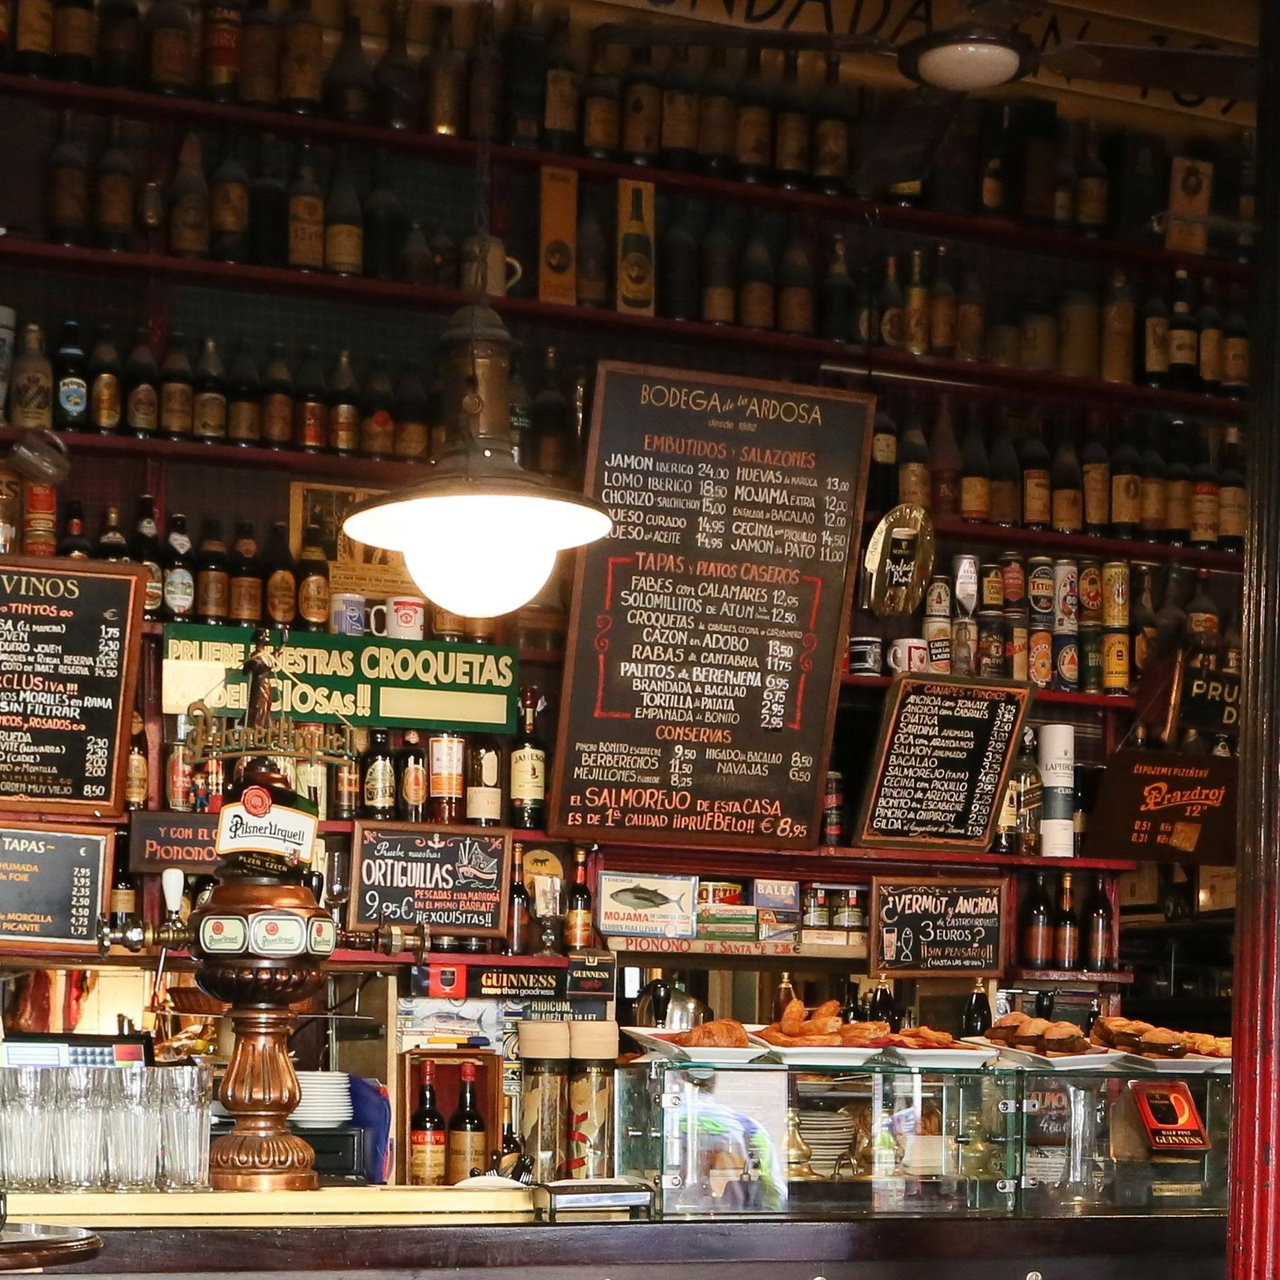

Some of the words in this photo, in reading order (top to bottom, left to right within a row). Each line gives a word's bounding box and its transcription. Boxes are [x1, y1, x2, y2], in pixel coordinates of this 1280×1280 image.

[641, 384, 721, 413] BODEGA
[746, 398, 822, 425] ARDOSA
[709, 419, 734, 430] desde
[644, 434, 727, 459] EMBUTIDOS
[740, 446, 816, 468] SALAZONES
[605, 453, 653, 470] JAMON
[656, 461, 694, 475] IBERICO
[604, 472, 644, 488] LOMO
[647, 475, 693, 494] IBERICO
[736, 466, 783, 484] HUEVAS
[734, 485, 789, 506] MOJAMA
[645, 513, 687, 529] CURADO
[732, 521, 774, 539] CECINA
[731, 539, 774, 554] JAMON
[784, 543, 815, 559] PATO
[635, 552, 684, 574] TAPAS
[696, 562, 737, 579] PLATOS
[740, 563, 800, 584] CASEROS
[885, 558, 915, 577] Perfect
[892, 571, 913, 584] Pint
[0, 574, 80, 599] VINOS
[631, 576, 672, 593] FABES
[675, 581, 696, 596] con
[698, 582, 768, 602] CALAMARES
[8, 602, 58, 617] TINTOS
[620, 591, 702, 614] SOLOMILLITOS
[720, 601, 754, 619] ATUN
[626, 609, 695, 630] CROQUETAS
[0, 641, 30, 653] DUERO
[33, 644, 62, 654] JOVEN
[702, 633, 750, 652] ADOBO
[631, 644, 684, 663] RABAS
[700, 652, 759, 668] CANTABRIA
[360, 645, 514, 688] CROQUETAS
[620, 661, 675, 680] PALITOS
[692, 667, 762, 688] BERENJENA
[632, 678, 692, 695] BRANDADA
[704, 684, 747, 698] BACALAO
[20, 691, 69, 705] MORILES
[83, 697, 113, 709] RAMA
[640, 692, 693, 710] TORTILLA
[701, 699, 735, 712] PATATA
[905, 695, 940, 706] ANCHOA
[956, 700, 989, 710] TOMATE
[0, 702, 24, 713] SIN
[27, 704, 80, 719] FILTRAR
[634, 707, 693, 723] EMPANADA
[704, 712, 740, 726] BONITO
[902, 704, 938, 715] ANCHOA
[901, 713, 938, 725] CHATKA
[655, 725, 732, 744] CONSERVAS
[898, 722, 939, 735] SARDINA
[705, 748, 739, 761] HIGADO
[892, 745, 932, 756] SALMON
[581, 753, 659, 770] BERBERECHOS
[889, 755, 937, 767] BACALAO
[573, 767, 637, 783] MEJILLONES
[717, 762, 769, 777] NAVAJAS
[886, 766, 945, 780] SALMOREJO
[931, 780, 967, 792] PIQUILLO
[585, 787, 692, 810] SALMOREJO
[697, 800, 710, 812] DE
[714, 801, 740, 814] ESTA
[742, 799, 782, 816] CASA
[924, 791, 967, 802] ARENQUE
[1141, 782, 1226, 811] Prazdroj
[567, 813, 581, 826] ES
[587, 814, 601, 825] DE
[625, 814, 669, 828] CALIDAD
[776, 818, 807, 838] 8,95
[873, 818, 902, 829] GILDA
[158, 826, 167, 838] Y
[169, 827, 193, 840] CON
[197, 828, 210, 840] EL
[2, 837, 46, 853] TAPAS
[374, 841, 405, 858] Pruebe
[408, 849, 441, 859] nuestras
[9, 872, 30, 882] FOIE
[362, 859, 453, 889] ORTIGUILLAS
[414, 889, 452, 900] PESCADAS
[757, 883, 795, 897] BALEA
[459, 900, 495, 912] BARBATE
[955, 896, 999, 915] ANCHOA
[7, 913, 53, 924] MORCILLA
[604, 911, 650, 922] MOJAMA
[2, 923, 41, 933] PICANTE
[919, 920, 934, 942] 3
[624, 938, 691, 953] PIONONO
[704, 943, 715, 952] DE
[720, 942, 752, 954] SANTA
[481, 973, 557, 988] GUINNESS
[572, 970, 609, 979] GUINNESS
[482, 987, 501, 995] more
[502, 987, 519, 995] than
[519, 988, 555, 996] goodness
[1155, 1136, 1203, 1145] GUINNESS
